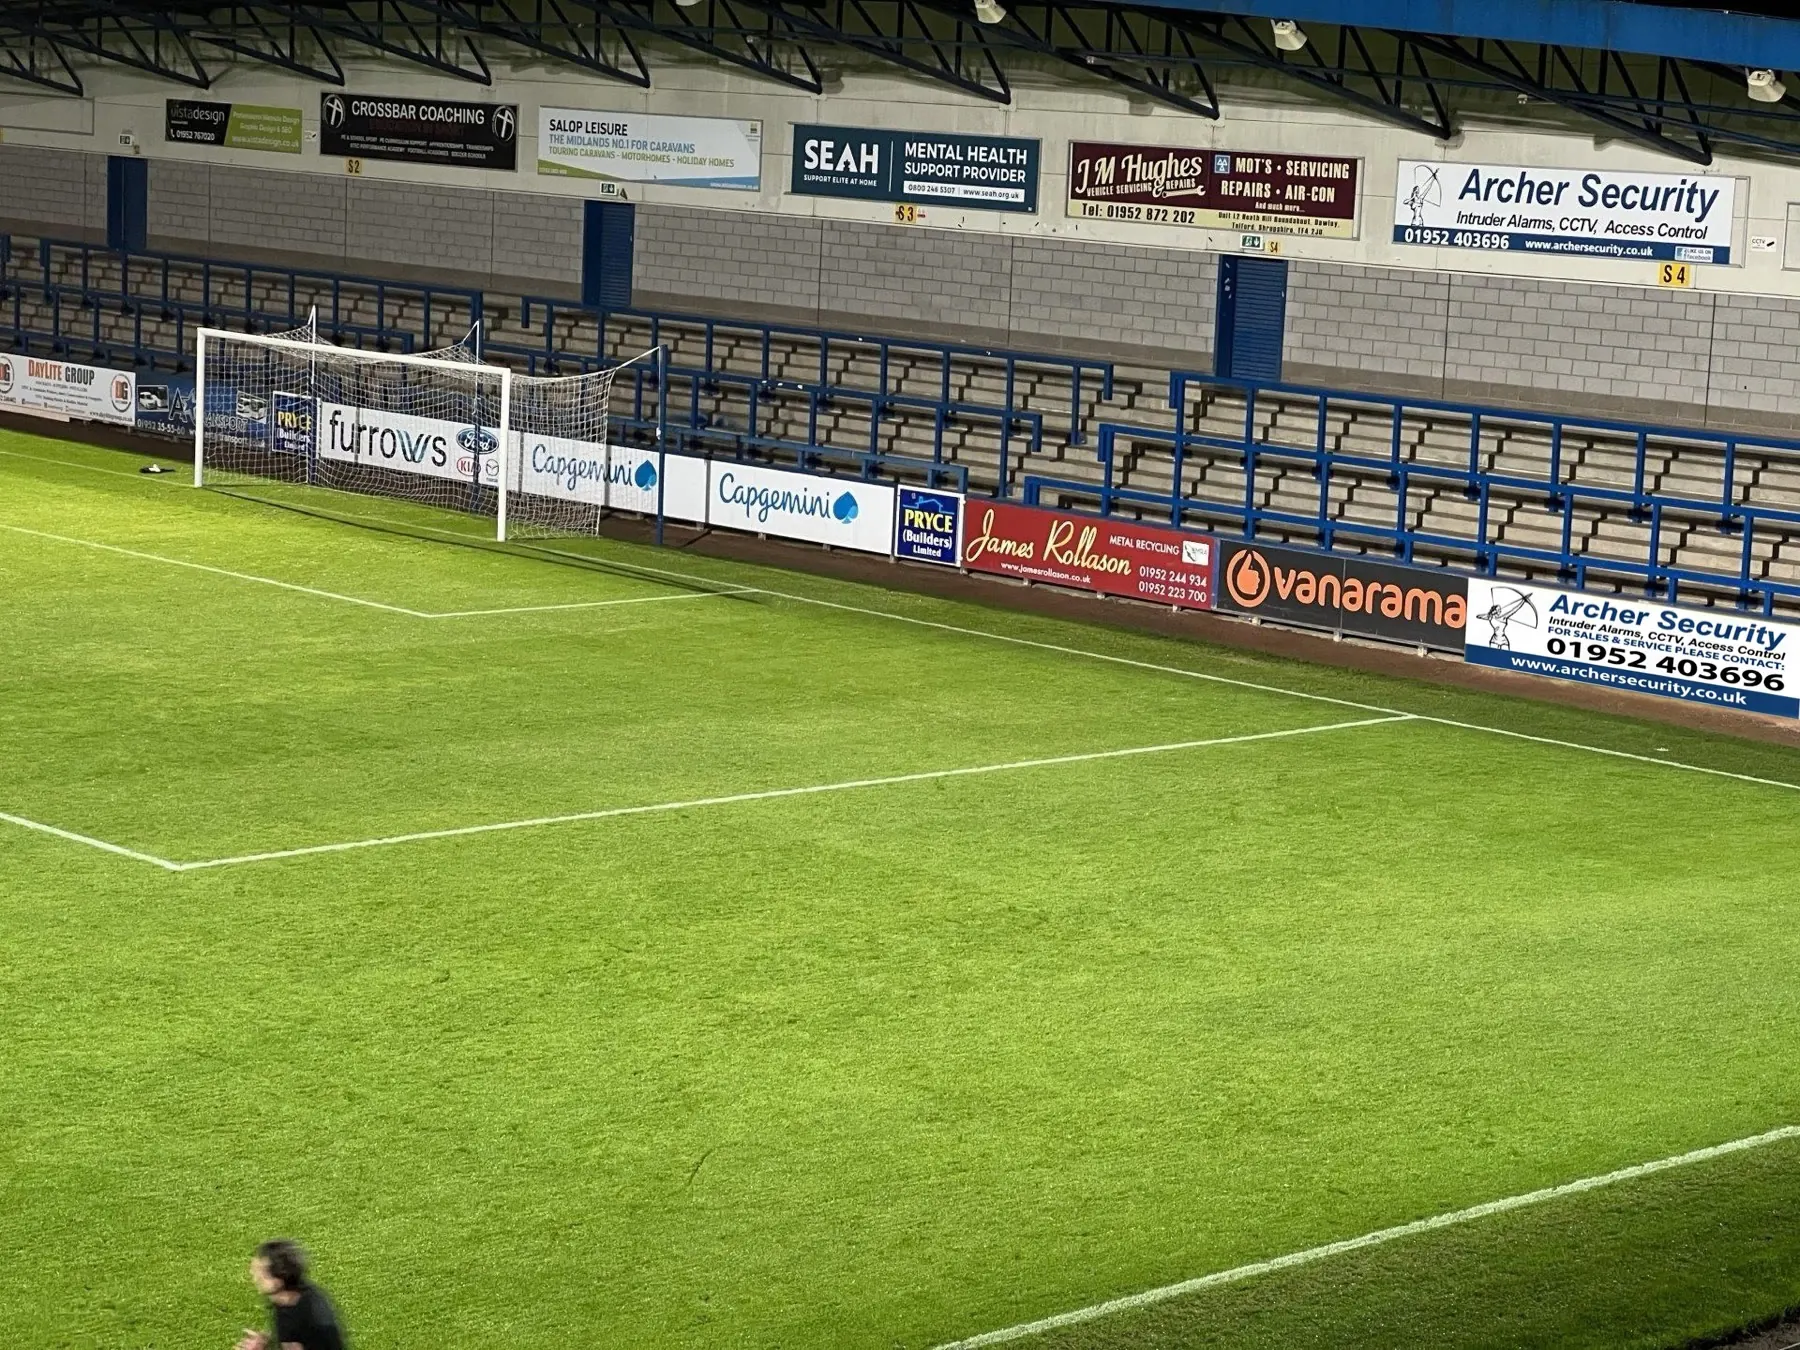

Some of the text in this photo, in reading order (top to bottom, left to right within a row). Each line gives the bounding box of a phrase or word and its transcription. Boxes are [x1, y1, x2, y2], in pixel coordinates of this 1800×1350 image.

[171, 105, 225, 125] vistadesign
[352, 101, 485, 125] CROSSBAR COACHING
[176, 130, 193, 139] 01952
[549, 119, 628, 136] SALOP LEISURE
[550, 134, 696, 154] THE MIDLANDS NO.1 FOR CARAVANS
[904, 141, 1028, 165] MENTAL HEALTH
[549, 146, 735, 168] TOURING CARAVANS MOTORHOMES HOLIDAY HOMES
[804, 139, 879, 174] SEAH
[1235, 157, 1350, 179] MOT'S SERVICING
[803, 174, 831, 183] SUPPORT
[832, 176, 849, 185] ELITE
[859, 179, 878, 187] HOME
[904, 161, 1026, 183] SUPPORT PROVIDER
[1075, 152, 1203, 194] J M Hughes
[908, 184, 1020, 200] 0800 246 5307 www.seah.org.uk
[1086, 178, 1196, 198] VEHICLE SERVICING & REPAIRS
[1221, 180, 1335, 203] REPAIRS AIR-CON
[1458, 168, 1720, 223] Archer Security
[1082, 203, 1195, 224] Tel: 01952 872 202
[1255, 201, 1267, 209] And
[1267, 202, 1283, 211] much
[1456, 211, 1709, 240] Intruder Alarms, CCTV, Access Control
[1404, 228, 1654, 256] 01952 403696 www.archersecurity.co.uk
[65, 366, 95, 386] GROUP
[329, 410, 447, 467] furrows
[532, 443, 633, 491] Capgemini
[720, 472, 831, 523] Capgemini
[904, 509, 953, 534] PRYCE
[902, 529, 953, 550] (Builders)
[912, 544, 942, 558] Limited
[966, 508, 1132, 576] James Rollason
[1109, 534, 1180, 556] METAL RECYCLING
[1000, 561, 1092, 584] www.jamesrollason.co.uk
[1139, 565, 1208, 588] 01952 244 934
[1138, 580, 1208, 603] 01952 223 700
[1273, 566, 1468, 629] vanarama
[1548, 594, 1787, 651] Archer Security
[1547, 626, 1785, 671] FOR SALES & SERVICE PLEASE CONTACT:
[1548, 616, 1786, 661] Intruder Alarms, CCTV, Access Control
[1546, 638, 1785, 692] 01952 403696
[1511, 656, 1748, 705] www.archersecurity.co.uk
